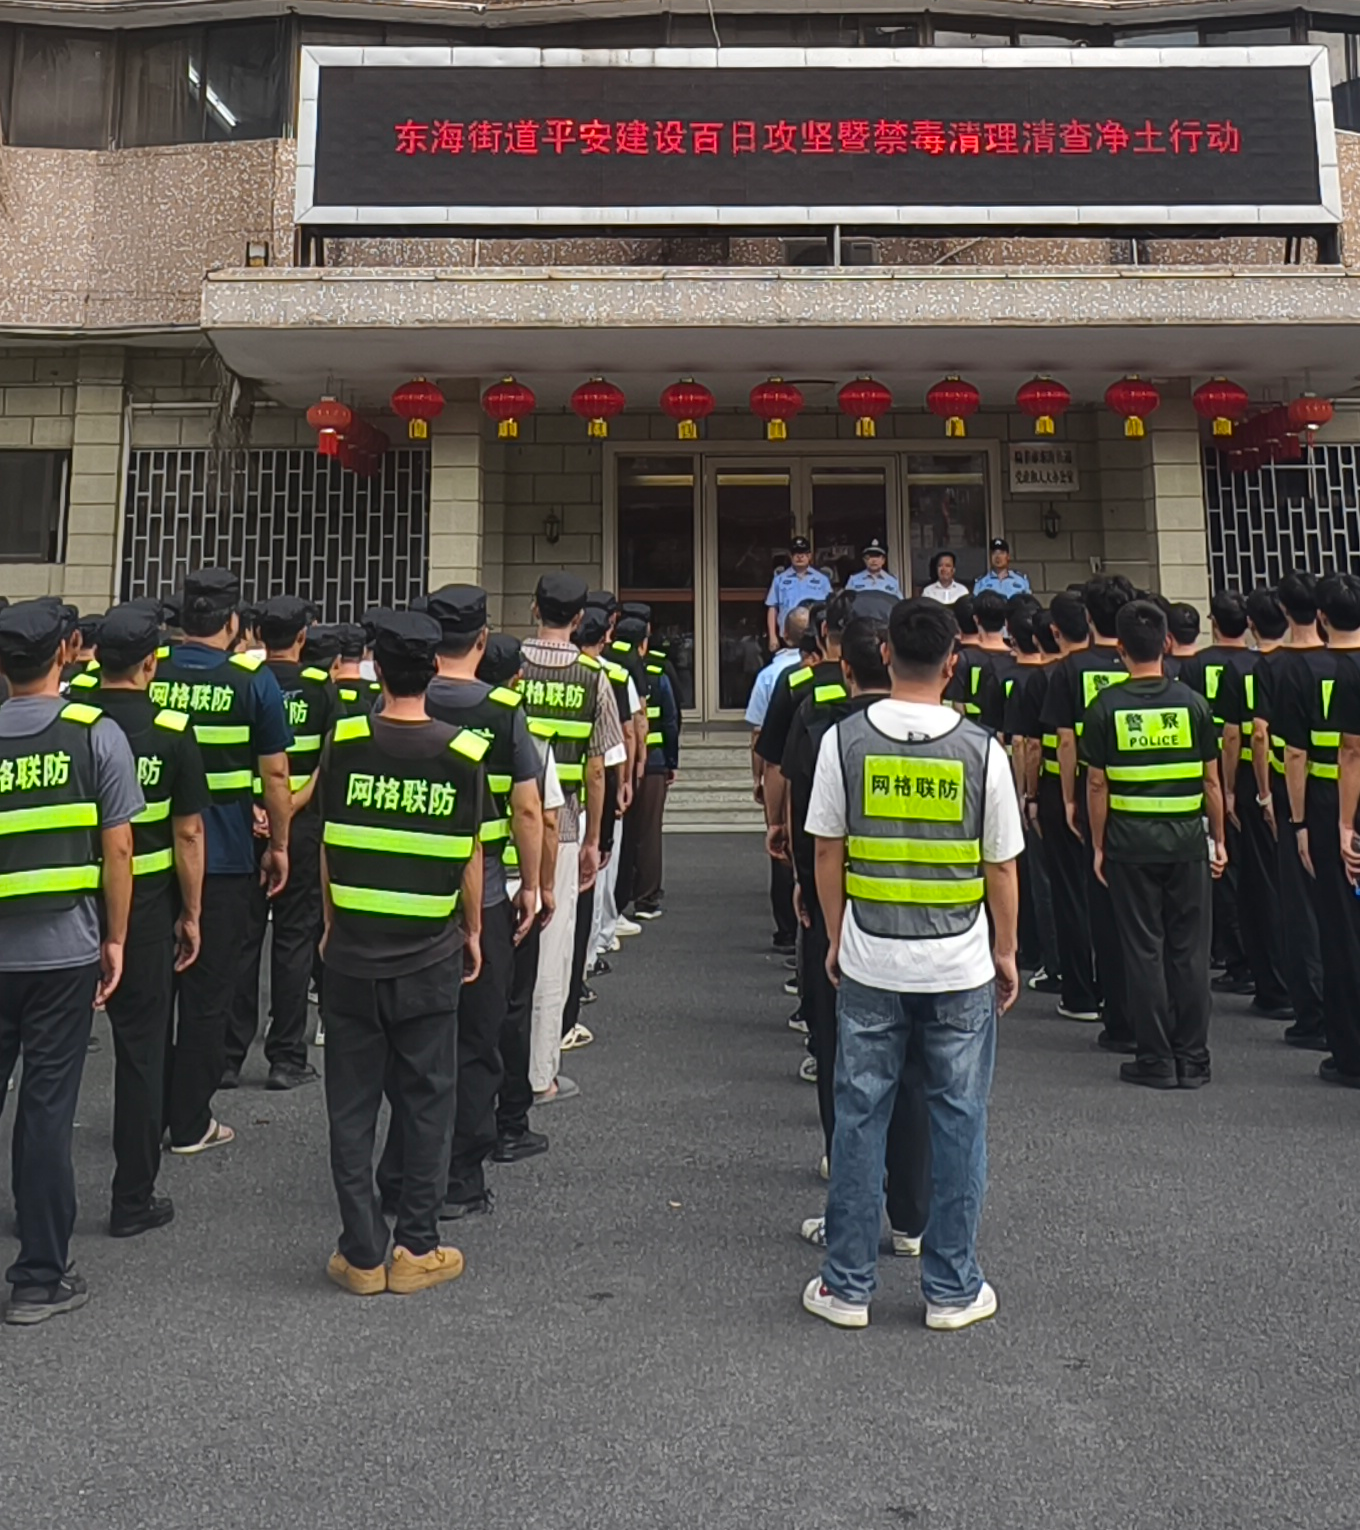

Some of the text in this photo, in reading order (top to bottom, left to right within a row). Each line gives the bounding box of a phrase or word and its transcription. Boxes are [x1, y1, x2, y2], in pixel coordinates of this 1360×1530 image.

[394, 118, 1241, 156] 东海街道平安建设百日攻坚暨禁毒清理清查净土行动
[149, 682, 234, 712] 网格联防
[1130, 735, 1179, 747] POLICE
[347, 773, 457, 816] 网格联防
[872, 775, 959, 801] 网格联防
